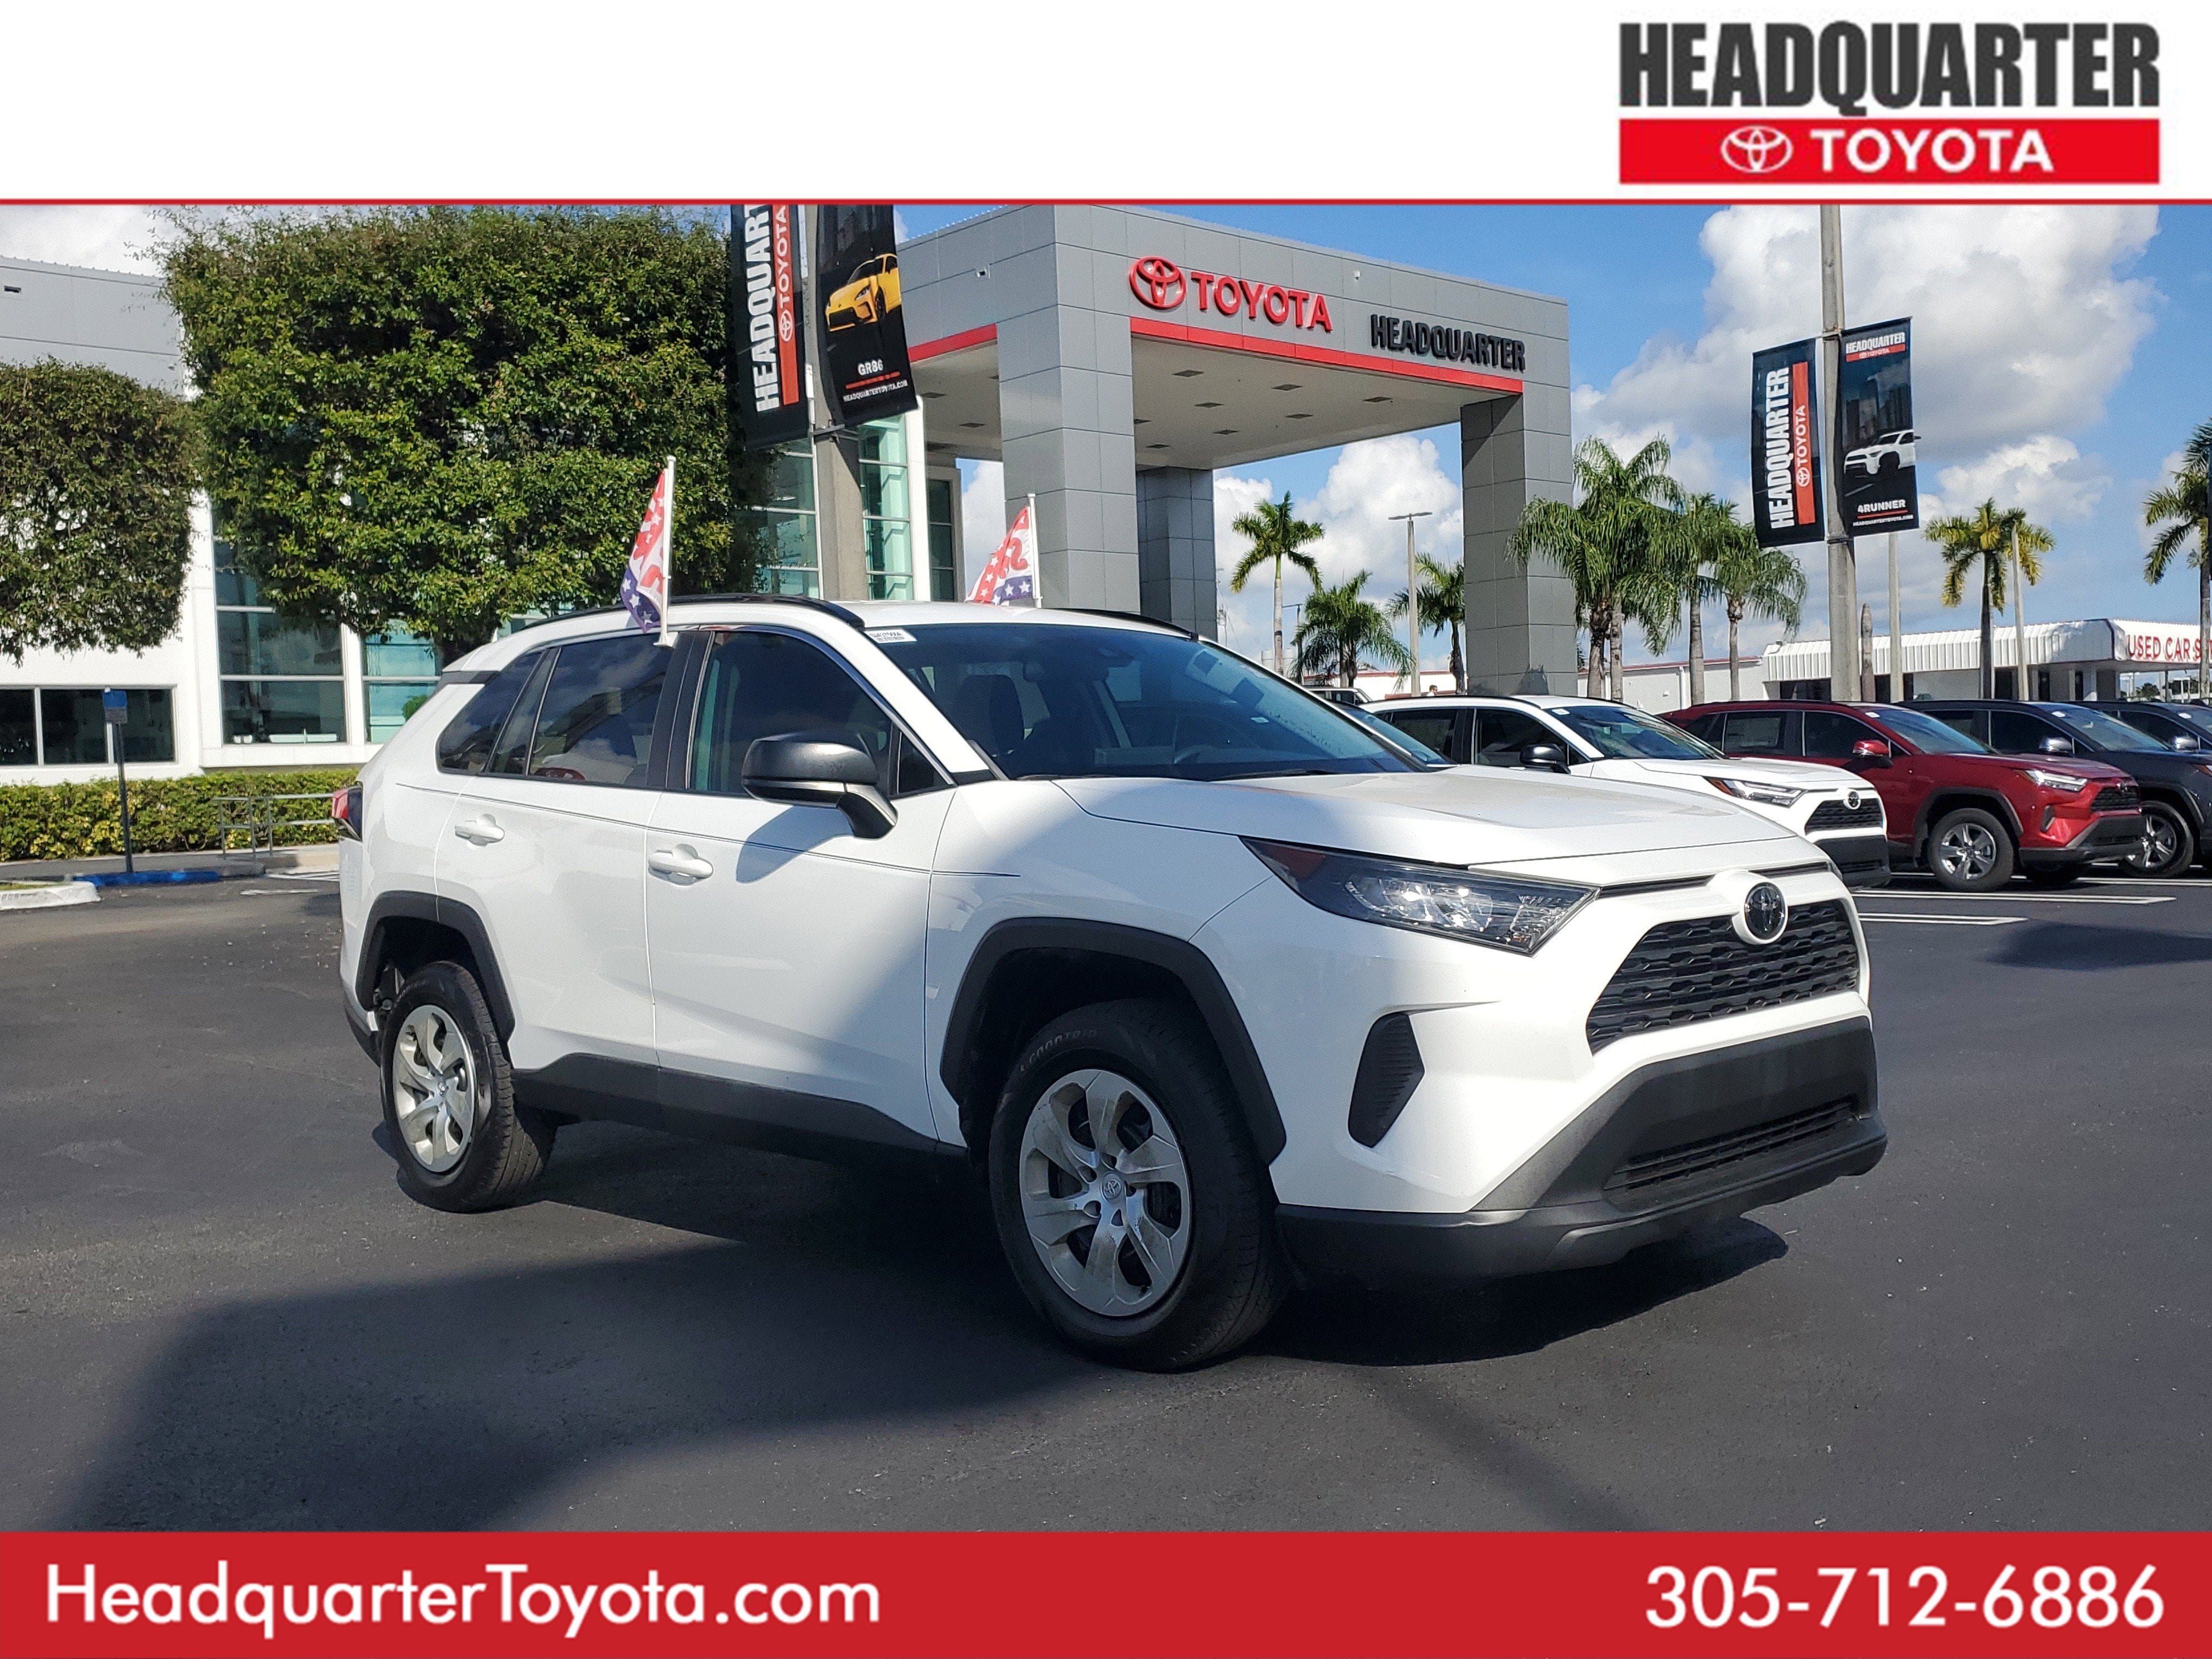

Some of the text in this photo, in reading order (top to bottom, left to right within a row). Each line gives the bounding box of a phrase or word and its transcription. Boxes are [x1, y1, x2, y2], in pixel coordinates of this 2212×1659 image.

[775, 205, 790, 309] TOYOTA
[1190, 272, 1526, 373] TOYOTA HEADQUARTER
[1846, 332, 1906, 354] HEADQUARTER
[857, 359, 884, 376] GR86
[1765, 366, 1795, 529] HEADQUARTER
[1795, 404, 1809, 467] TOYOTA
[1858, 499, 1906, 514] 4RUNNER
[2127, 634, 2161, 659] USED
[2165, 636, 2191, 661] CAR
